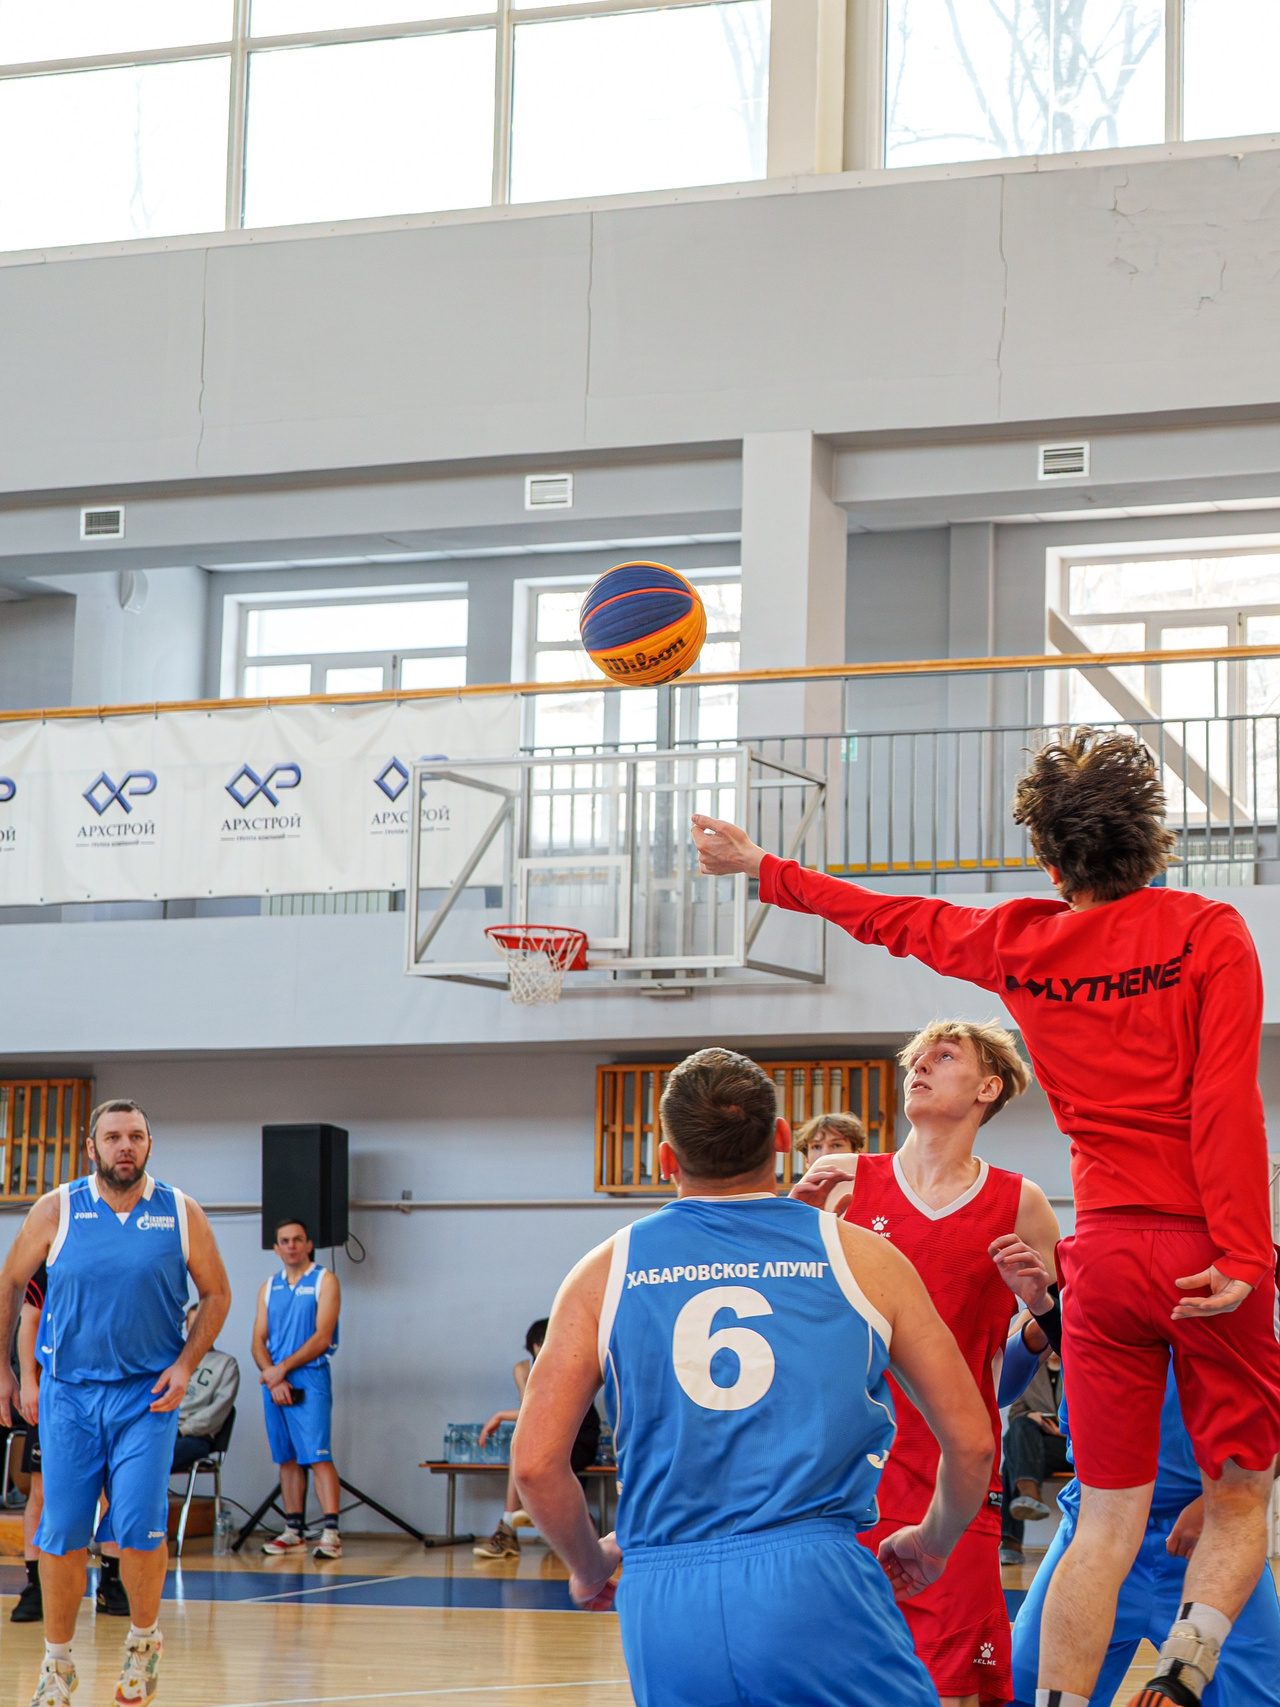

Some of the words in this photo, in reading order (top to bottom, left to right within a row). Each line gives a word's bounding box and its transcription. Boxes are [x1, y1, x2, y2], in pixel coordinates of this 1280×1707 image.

[602, 636, 685, 676] Wilson
[76, 819, 156, 838] АРХСТРОЙ
[220, 812, 302, 831] АРХСТРОЙ
[626, 1262, 760, 1290] ХАБАРОВСКОЕ
[762, 1261, 829, 1279] ЛПУМГ
[672, 1285, 776, 1412] 6
[972, 1658, 997, 1666] KELME
